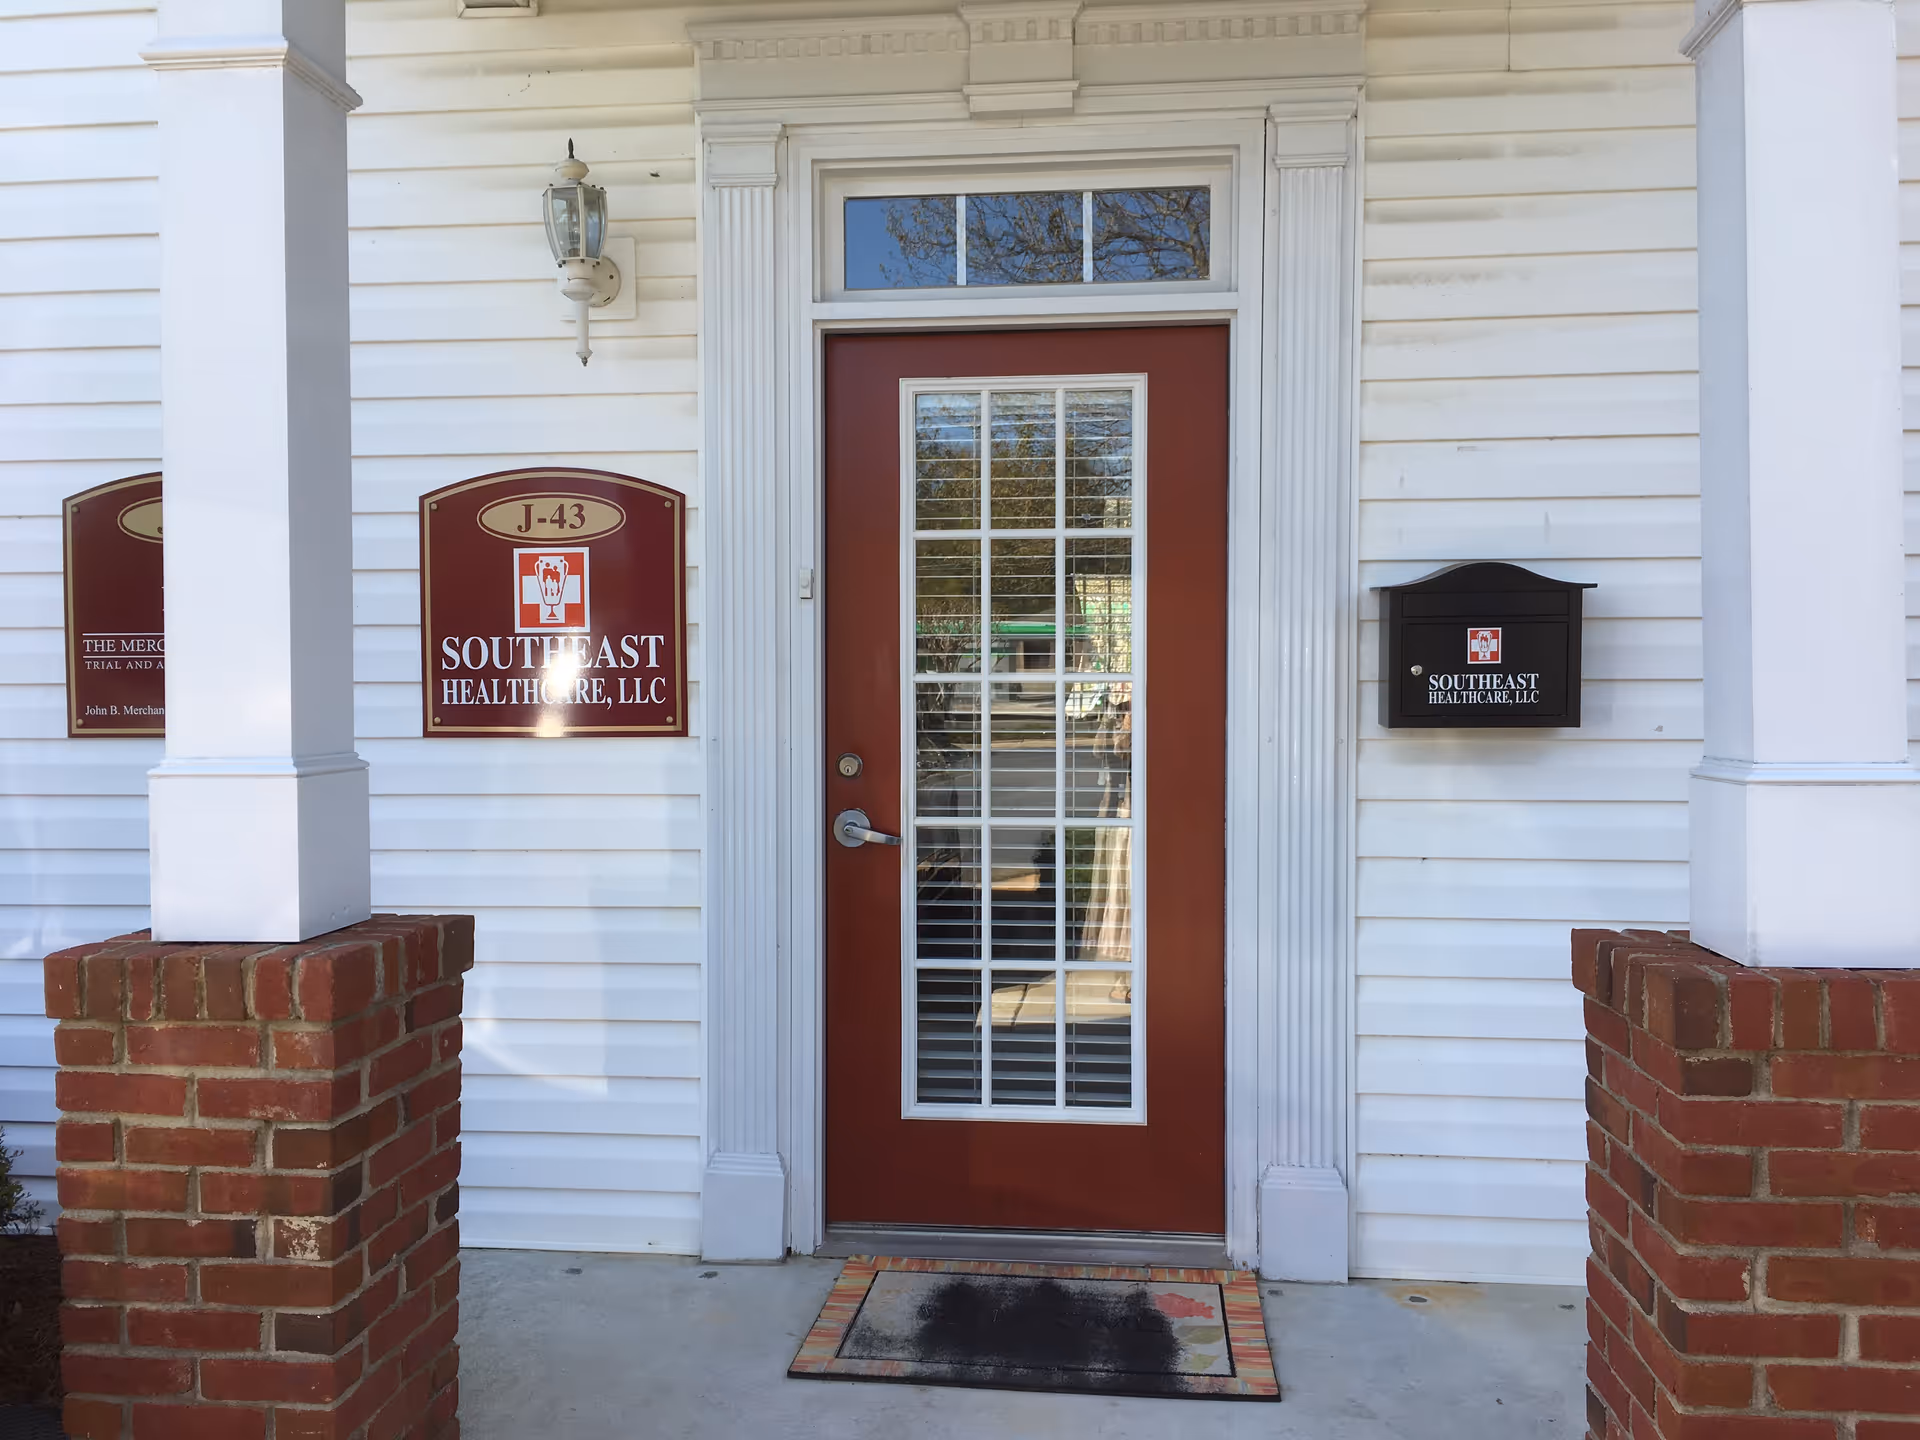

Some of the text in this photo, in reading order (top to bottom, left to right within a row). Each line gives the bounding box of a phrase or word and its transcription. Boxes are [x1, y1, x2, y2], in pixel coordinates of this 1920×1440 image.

[517, 503, 586, 533] J-43
[82, 639, 117, 652] THE
[441, 634, 665, 670] SOUTHEAST
[85, 660, 121, 670] TRIAL
[126, 660, 153, 670] AND
[1428, 673, 1539, 690] SOUTHEAST
[441, 676, 667, 710] HEALTHCRE, LLC
[1428, 690, 1540, 706] HEALTHCARE, LLC
[85, 704, 108, 715] John
[110, 704, 121, 715] B.
